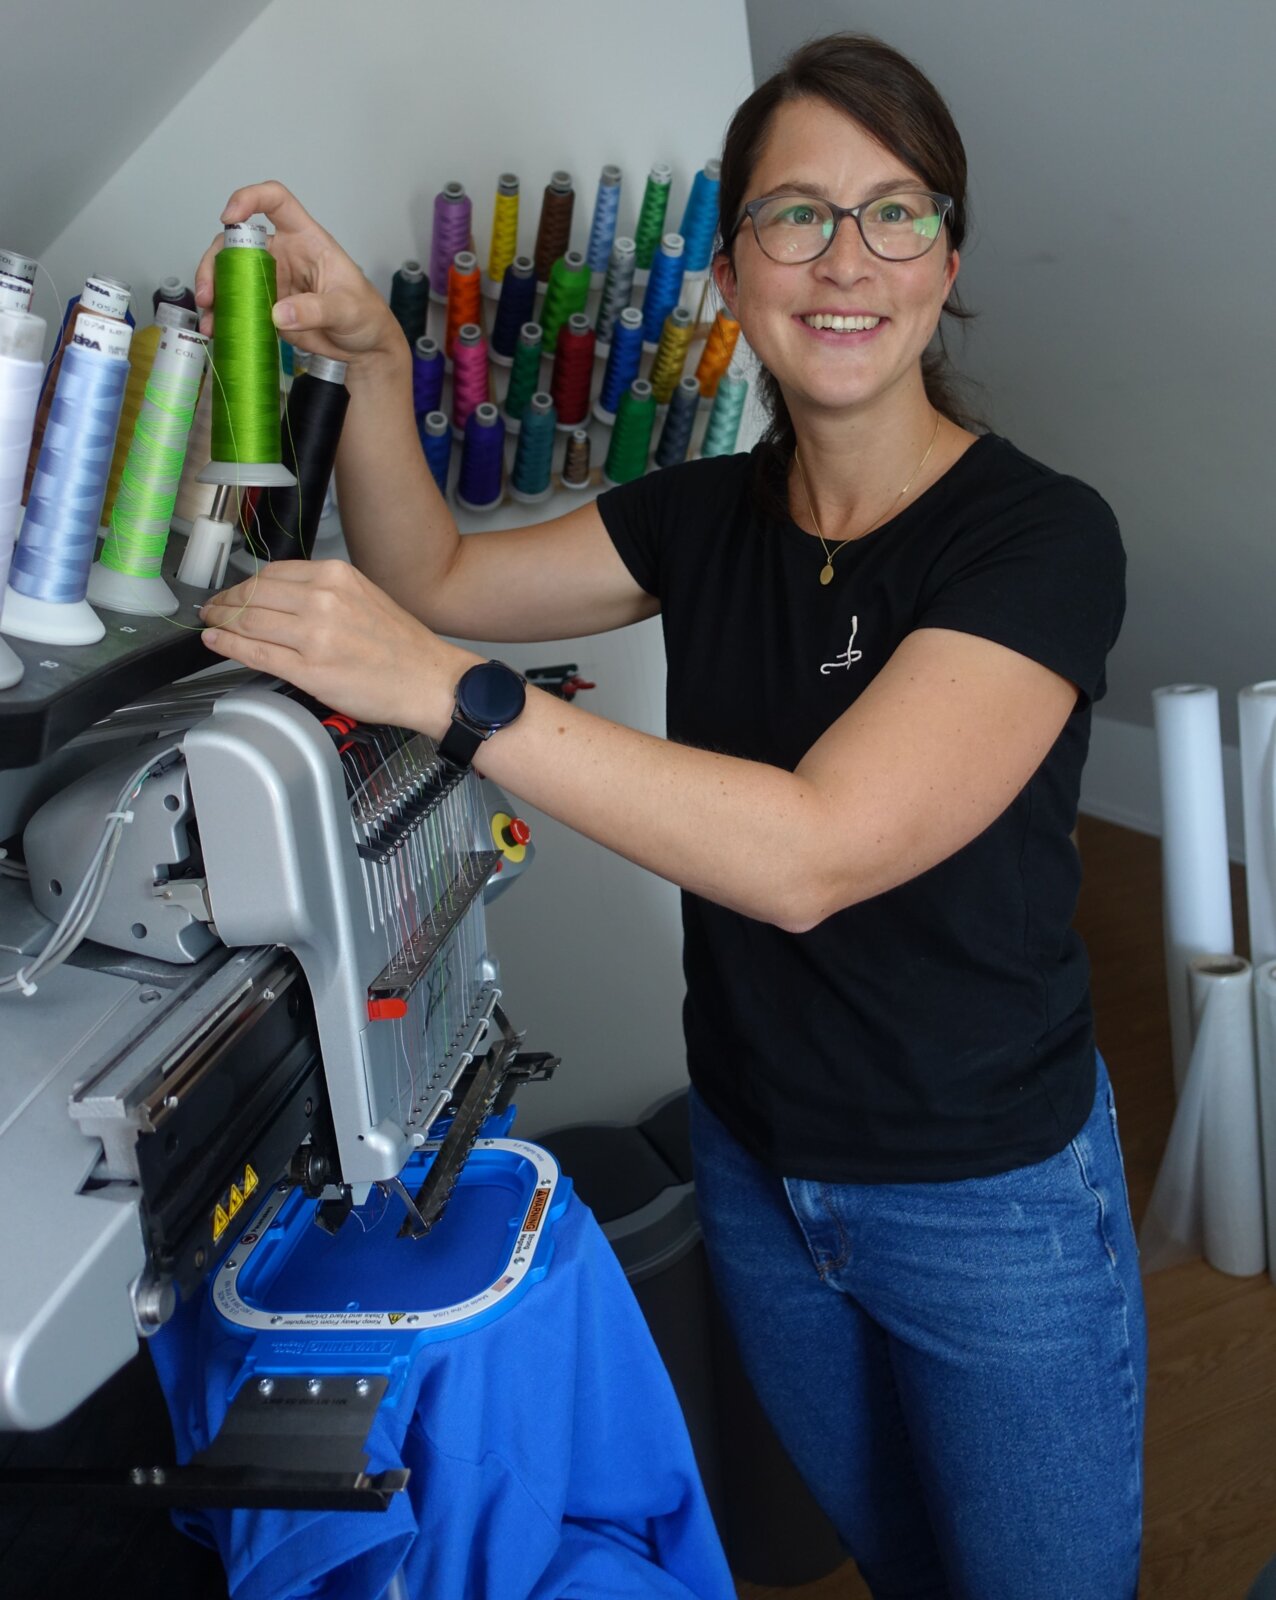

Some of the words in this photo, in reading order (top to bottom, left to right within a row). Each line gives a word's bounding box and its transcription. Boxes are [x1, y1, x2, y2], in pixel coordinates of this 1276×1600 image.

[39, 659, 60, 669] 15
[526, 1195, 545, 1230] WARNING
[432, 1310, 449, 1318] USA
